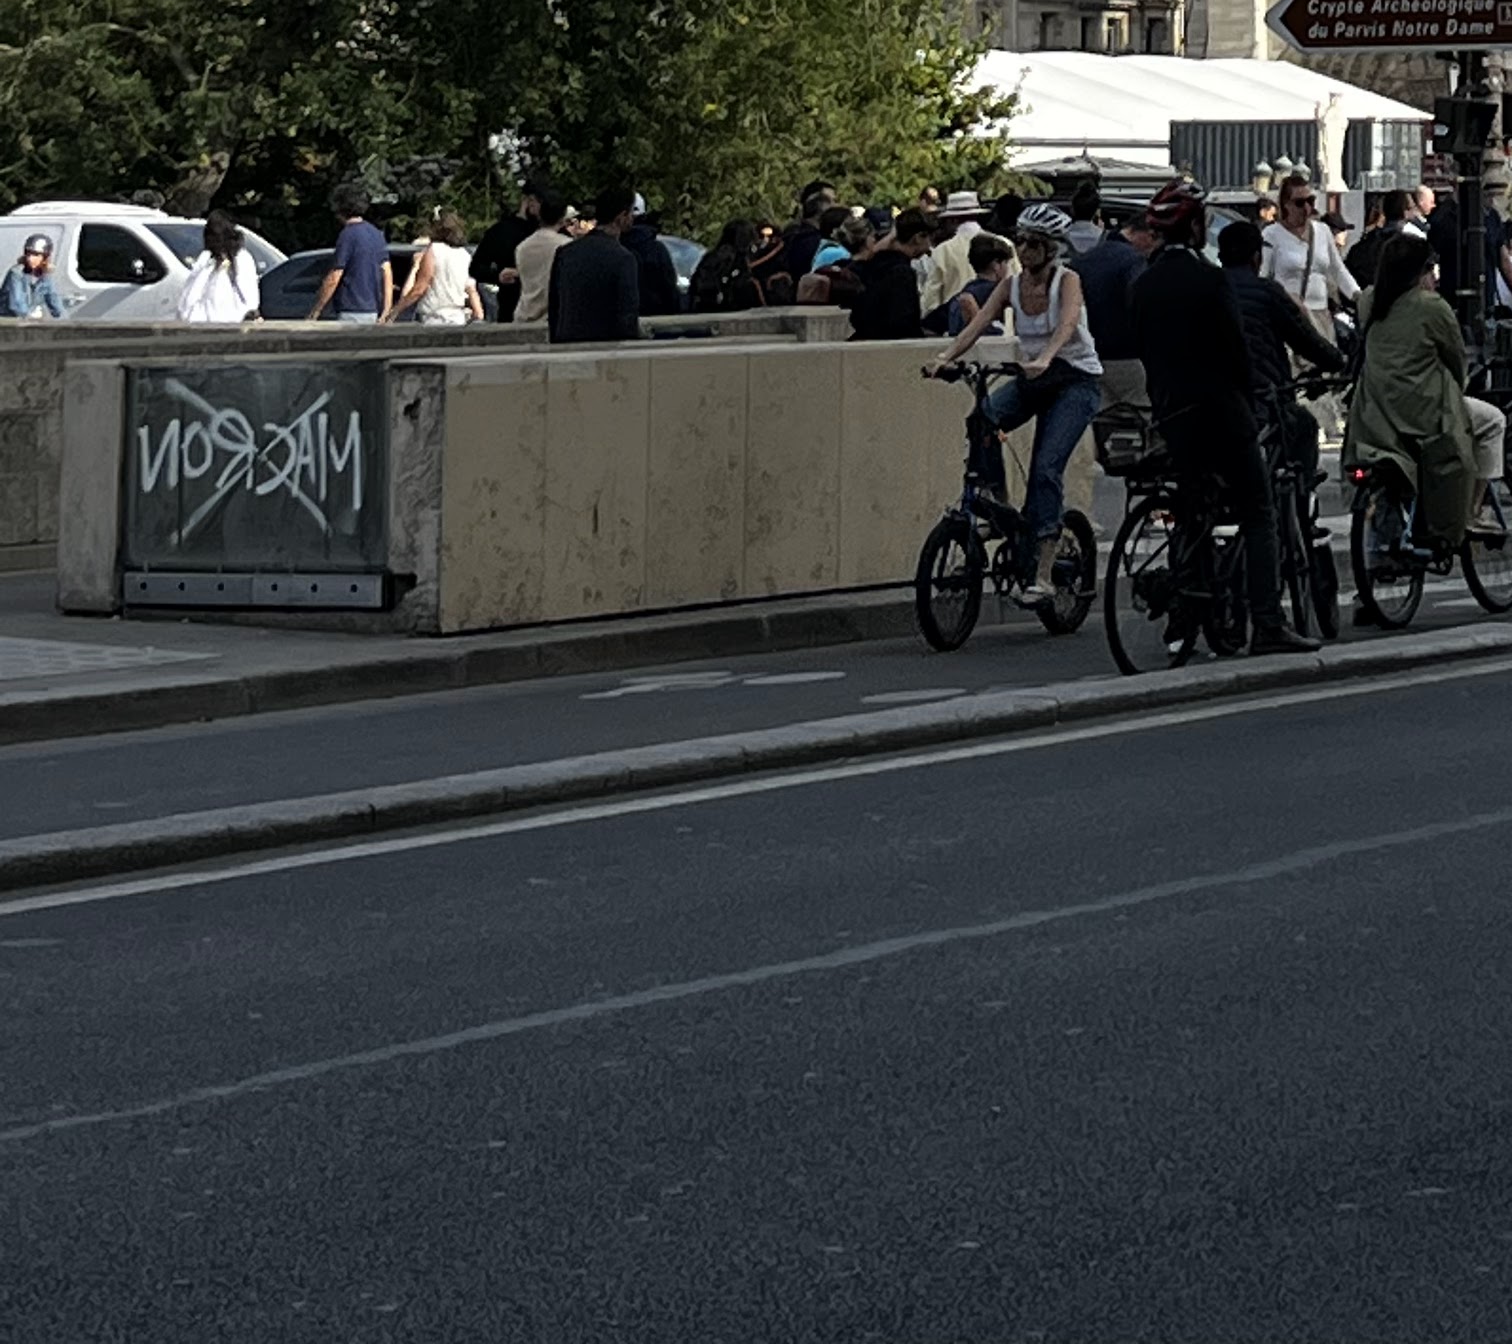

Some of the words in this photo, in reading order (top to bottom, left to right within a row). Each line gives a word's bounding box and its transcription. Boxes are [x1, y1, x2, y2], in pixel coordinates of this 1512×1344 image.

[1308, 21, 1329, 38] du
[1333, 20, 1386, 38] Parvis
[1391, 19, 1439, 37] Notre
[1445, 18, 1495, 36] Dame
